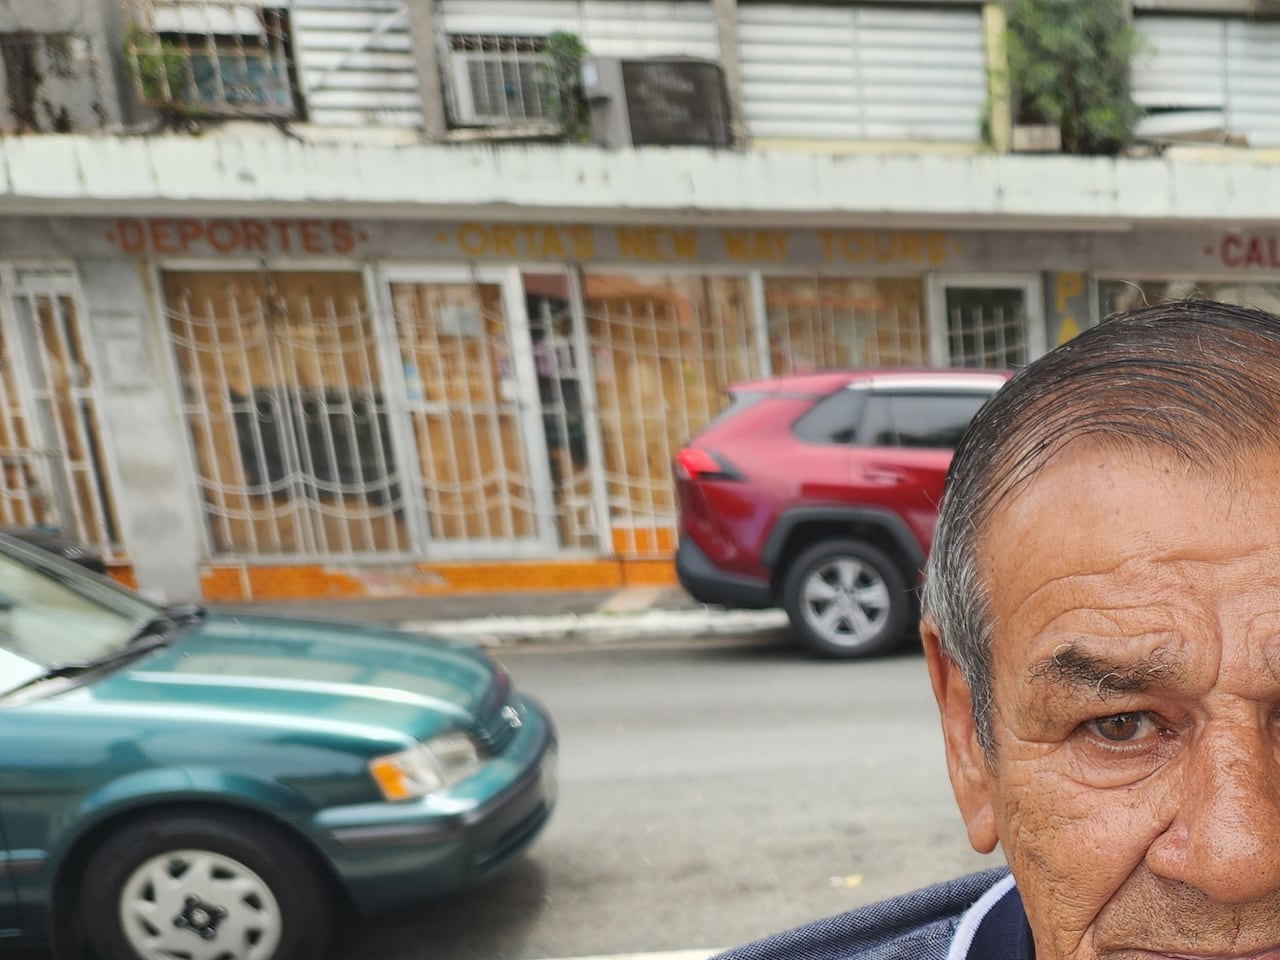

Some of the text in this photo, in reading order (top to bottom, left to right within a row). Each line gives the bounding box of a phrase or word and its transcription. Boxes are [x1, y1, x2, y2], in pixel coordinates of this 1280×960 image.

[115, 218, 356, 254] DEPORTES
[616, 226, 697, 262] NEW
[721, 228, 791, 263] WAY
[817, 230, 946, 265] TOURS
